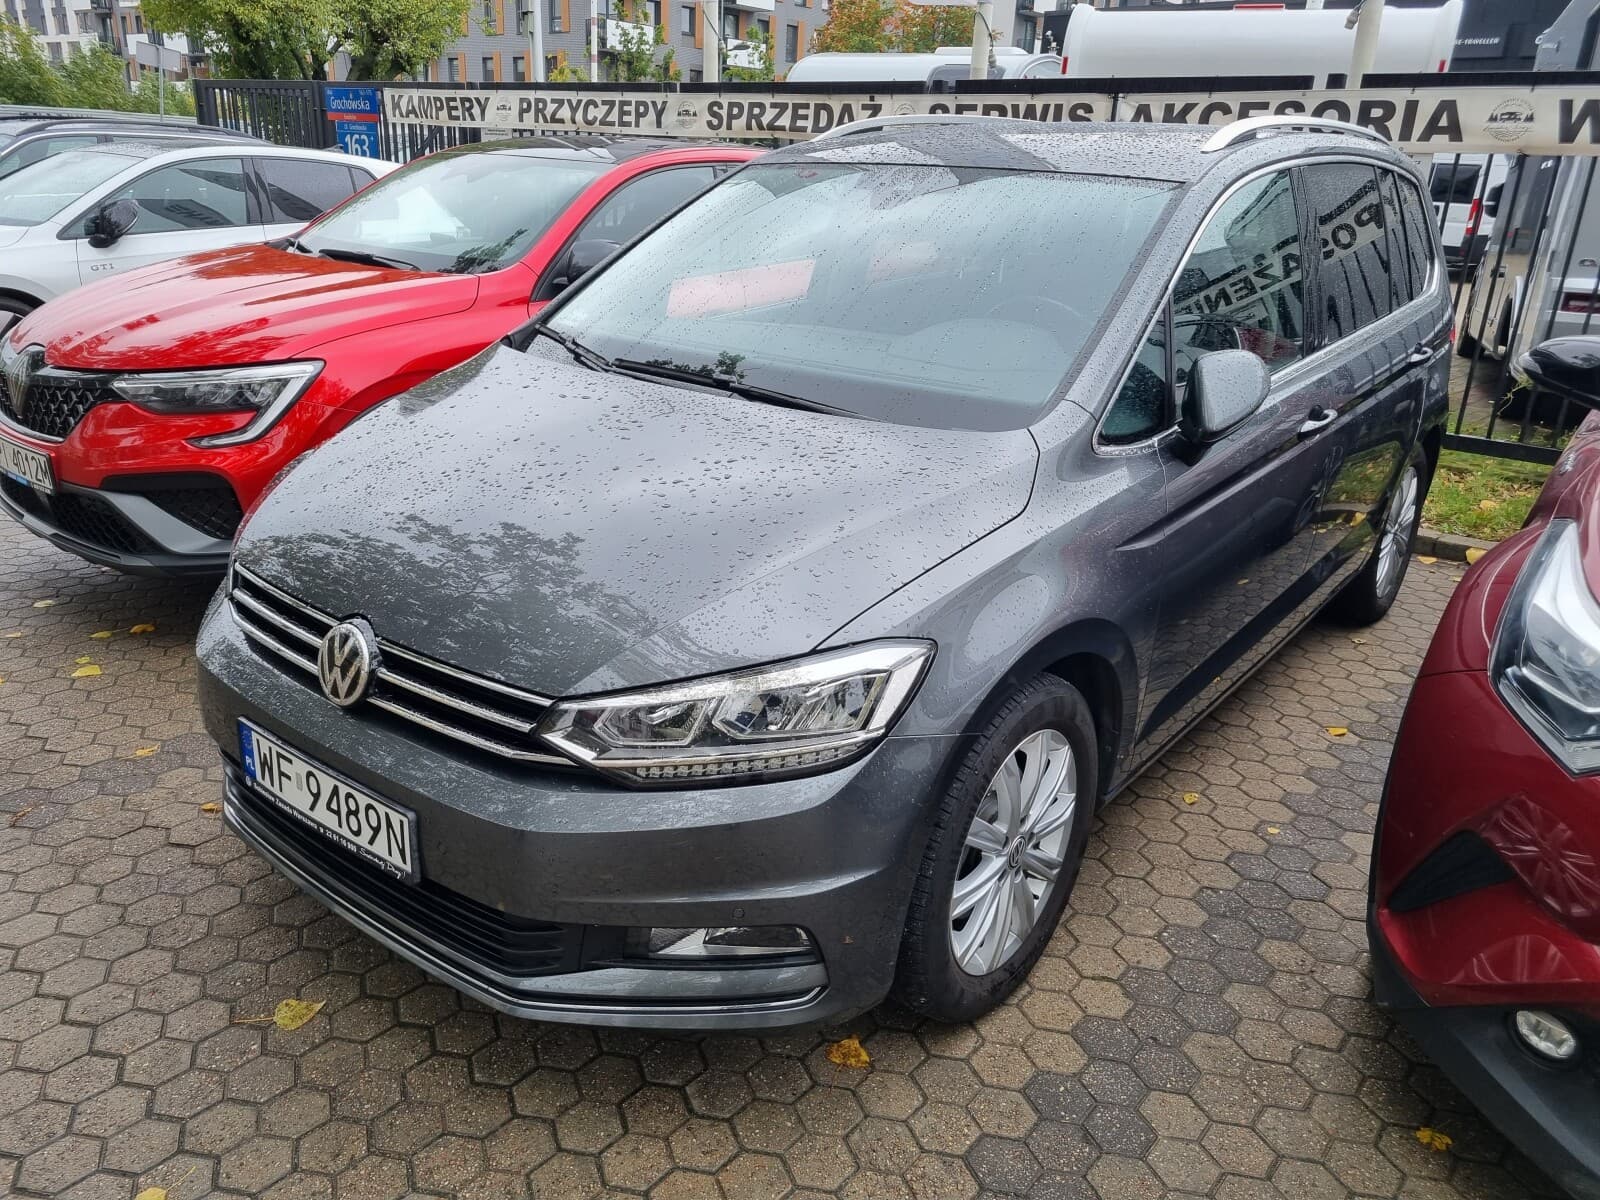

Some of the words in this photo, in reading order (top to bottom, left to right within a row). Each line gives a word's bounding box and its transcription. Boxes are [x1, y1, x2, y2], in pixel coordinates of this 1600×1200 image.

[330, 96, 370, 110] Grochowska
[390, 94, 490, 121] KAMPERY
[518, 97, 668, 128] PRZYCZEPY
[345, 133, 371, 157] 163
[90, 263, 115, 272] GTI
[245, 755, 255, 771] PL
[256, 738, 293, 793] WF
[305, 770, 407, 865] 9489N
